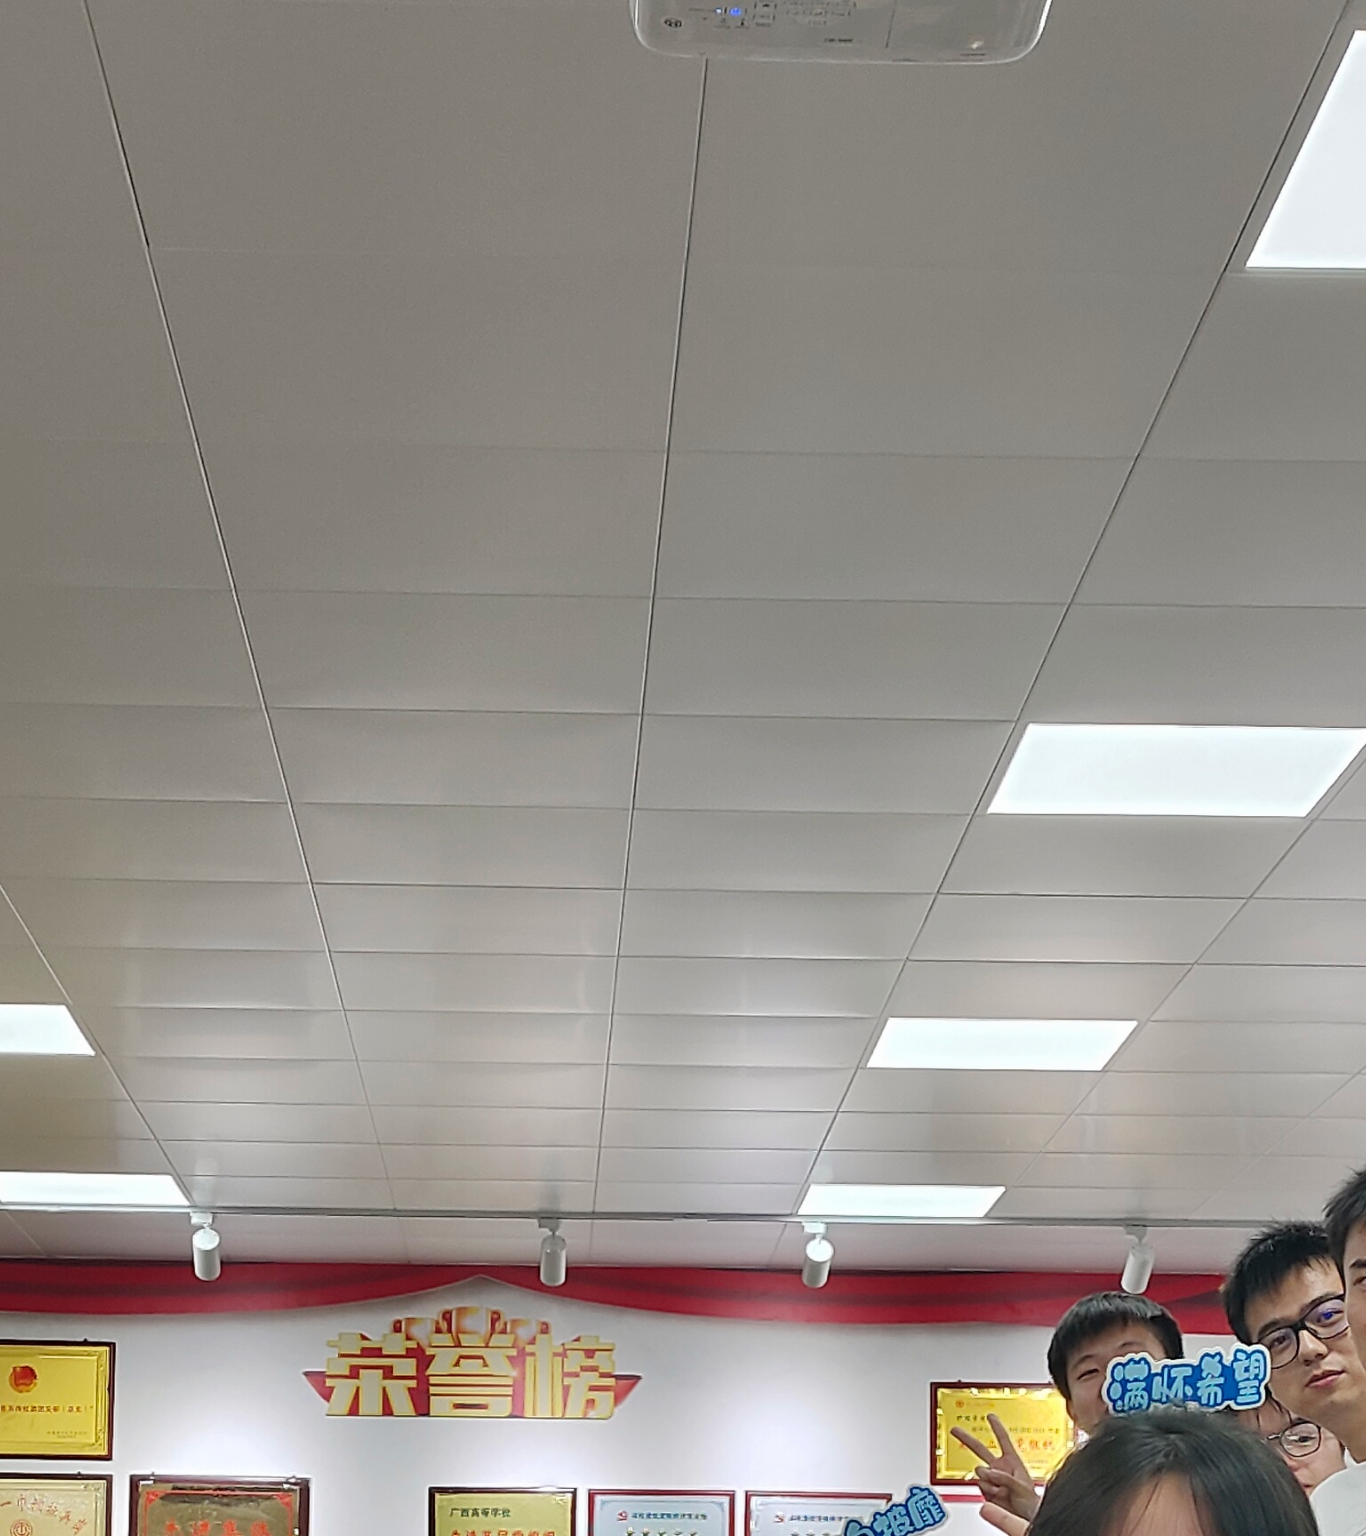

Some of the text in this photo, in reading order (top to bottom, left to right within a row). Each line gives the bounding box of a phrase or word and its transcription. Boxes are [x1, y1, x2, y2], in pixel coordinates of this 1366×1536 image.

[326, 1333, 616, 1419] 荣誉榜
[1109, 1351, 1266, 1410] 满怀希望
[449, 1507, 511, 1518] 广西高等学校
